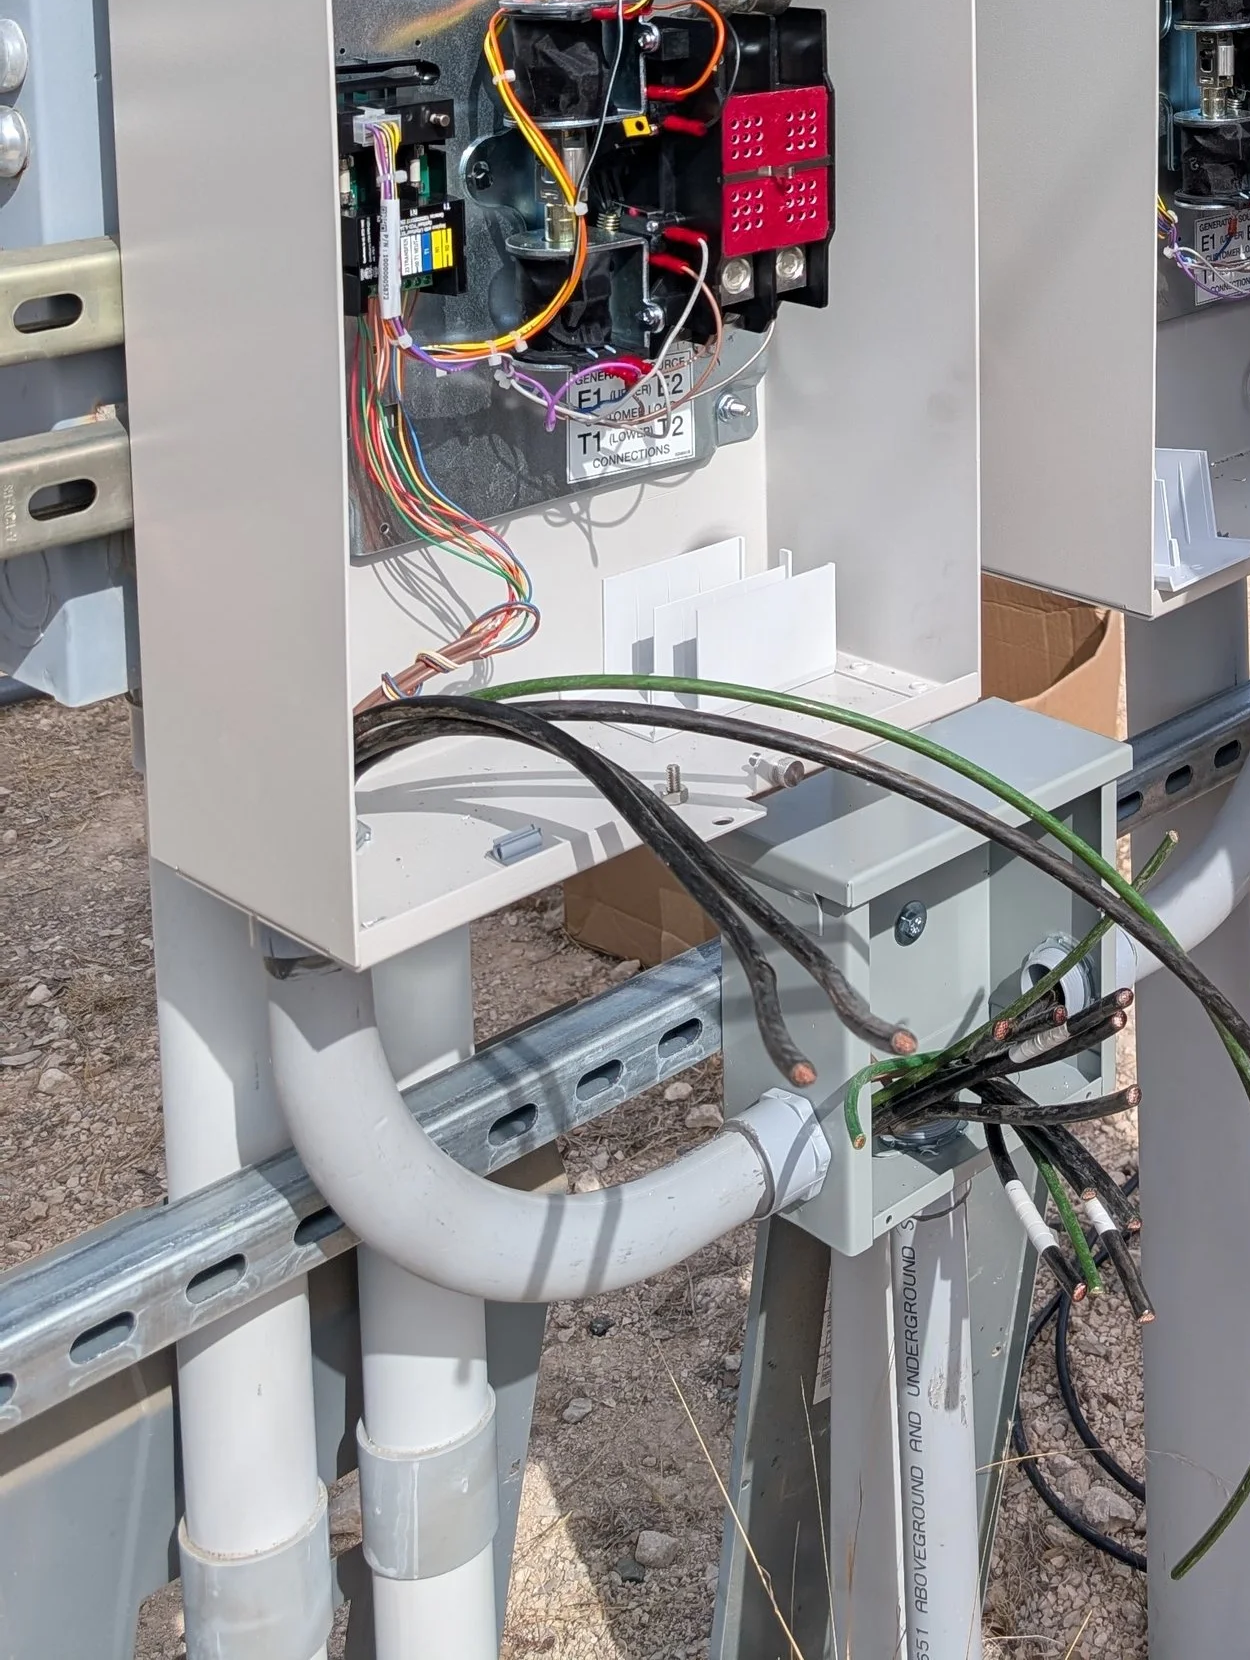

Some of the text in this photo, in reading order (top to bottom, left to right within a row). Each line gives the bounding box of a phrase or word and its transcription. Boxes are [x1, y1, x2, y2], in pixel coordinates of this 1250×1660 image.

[1201, 234, 1215, 252] E1
[657, 373, 684, 398] E2
[577, 431, 601, 455] T1
[657, 415, 684, 438] T2
[592, 444, 671, 469] CONNECTIONS
[901, 1246, 921, 1397] UNDERGROUND
[908, 1411, 923, 1453] AND
[910, 1465, 928, 1614] ABOVEGROUND
